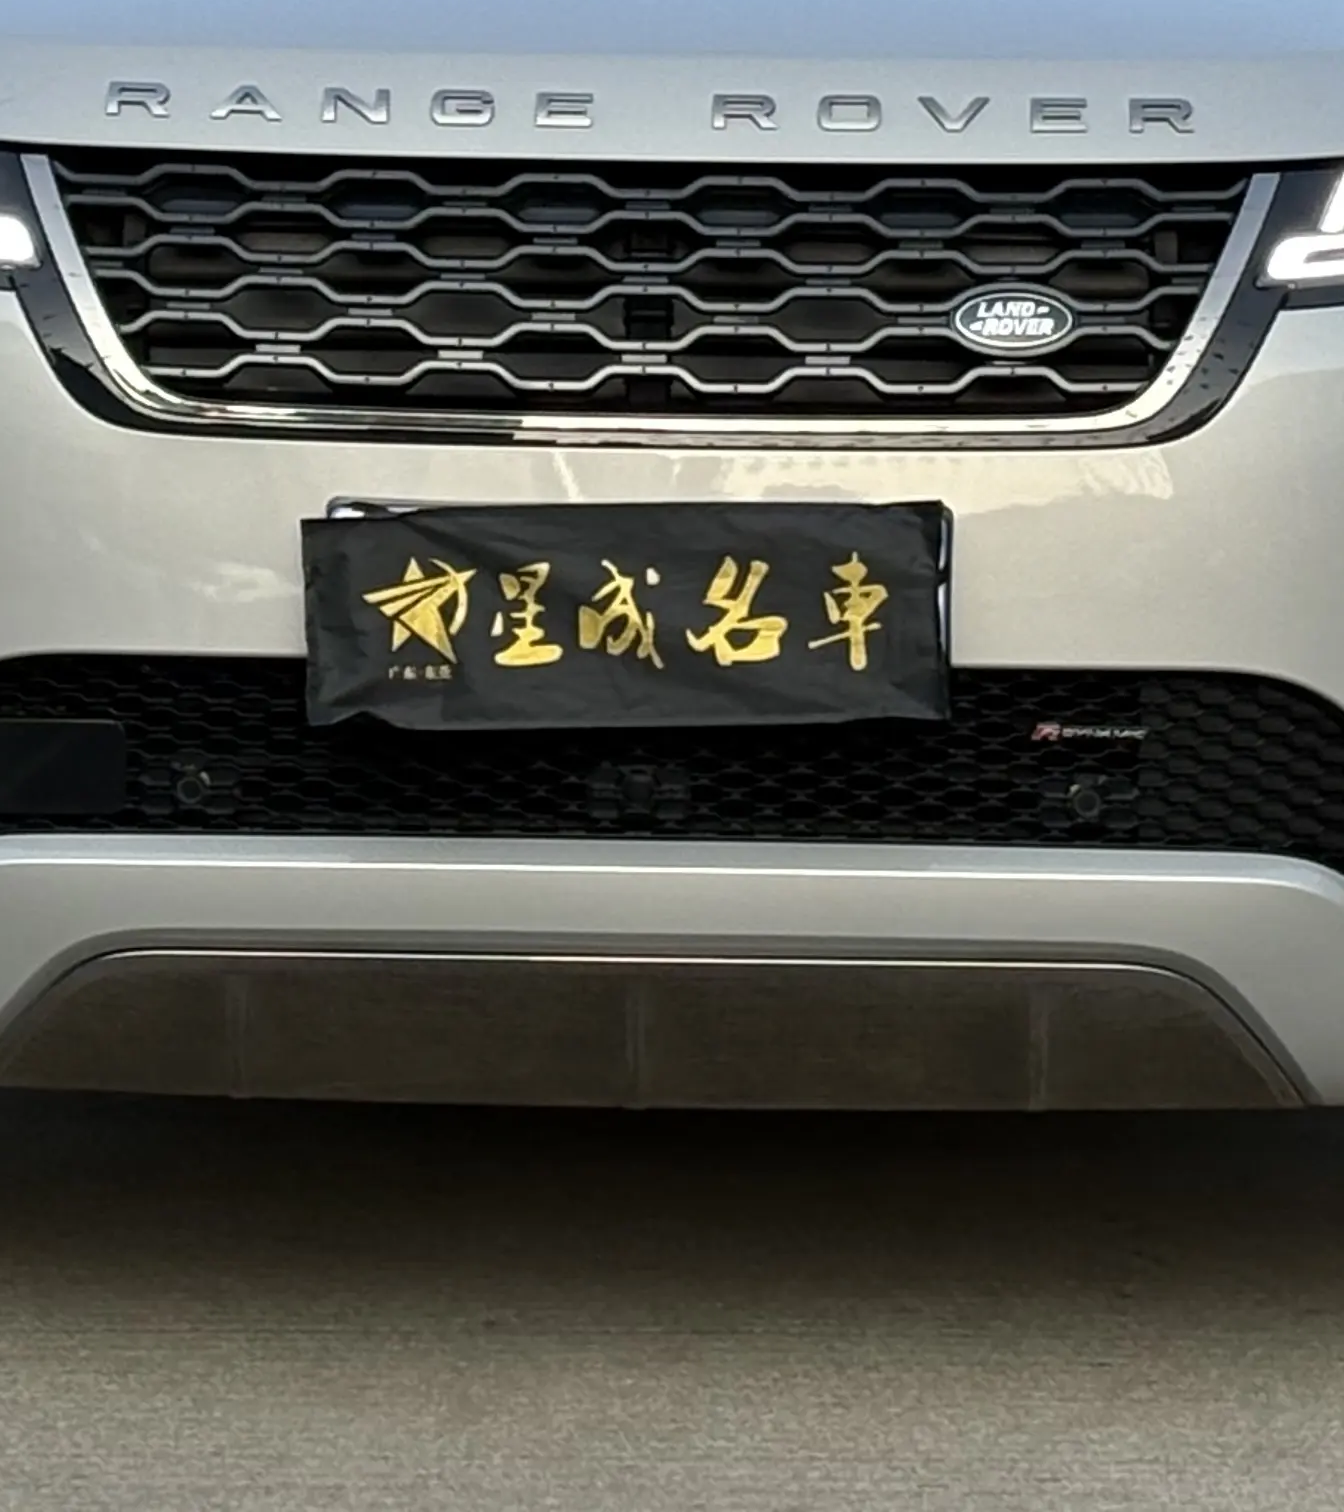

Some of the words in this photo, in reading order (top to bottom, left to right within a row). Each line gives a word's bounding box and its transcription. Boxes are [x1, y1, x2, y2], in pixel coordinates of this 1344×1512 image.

[105, 80, 596, 130] RANGE
[709, 92, 1198, 135] ROVER
[976, 301, 1036, 318] LAND
[981, 317, 1056, 336] ROVER
